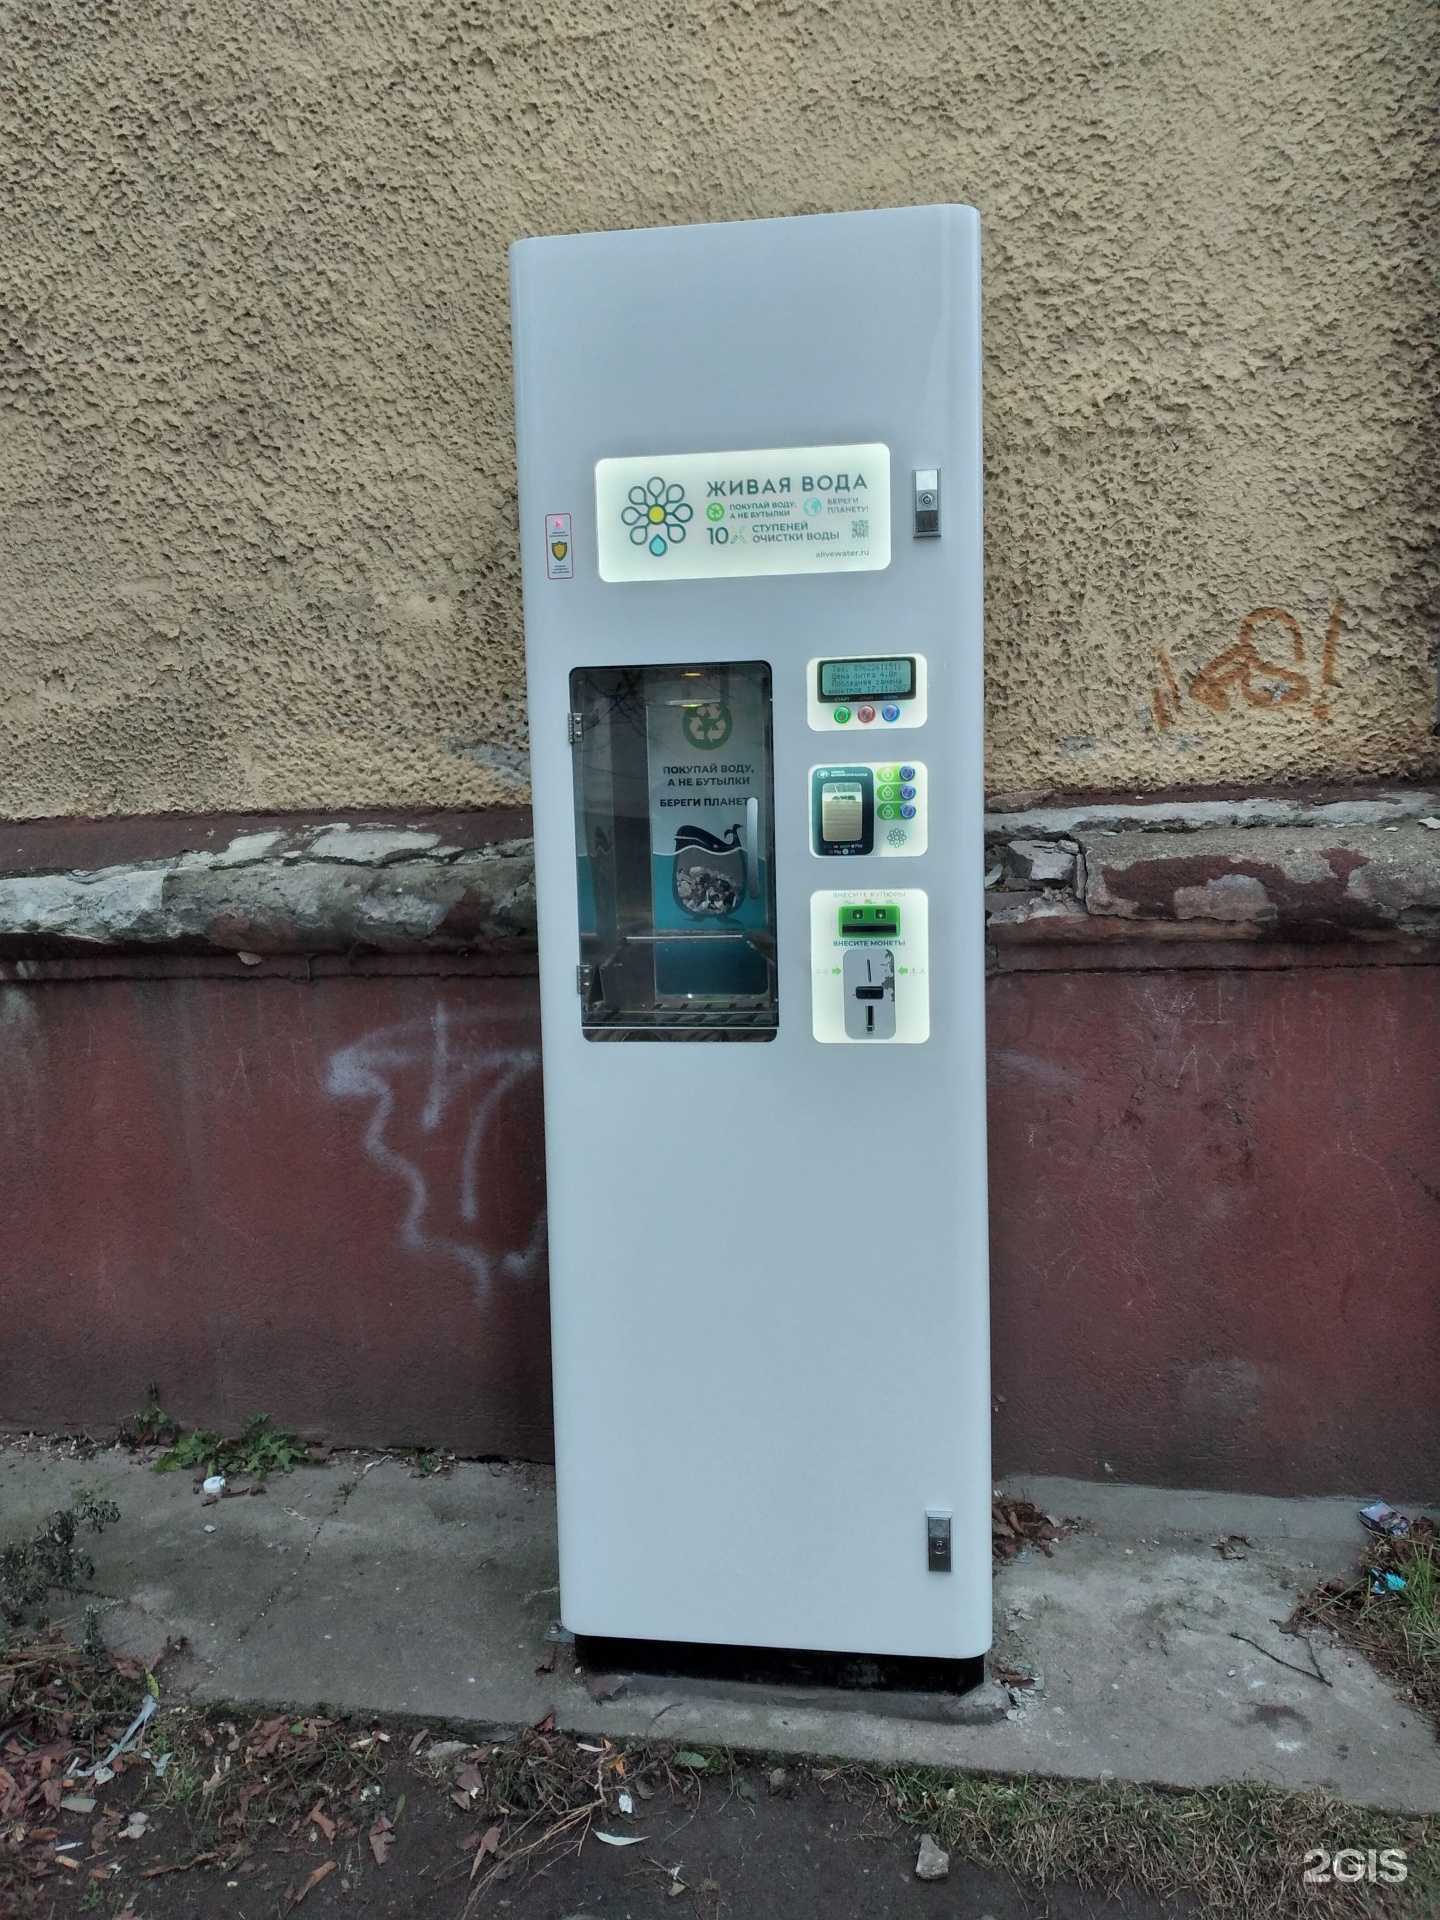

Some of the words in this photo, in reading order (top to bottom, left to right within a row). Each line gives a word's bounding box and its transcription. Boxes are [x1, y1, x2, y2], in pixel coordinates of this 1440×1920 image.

[706, 476, 791, 498] ЖИВАЯ
[801, 473, 868, 493] ВОДА
[729, 501, 770, 511] ПОКУПАЙ
[827, 505, 869, 514] ПЛАНЕТУ!
[729, 512, 736, 520] А
[737, 511, 749, 519] НЕ
[750, 509, 791, 519] БУТЫЛКИ
[752, 521, 809, 534] СТУПЕНЕЙ
[706, 526, 729, 545] 10
[752, 532, 805, 544] ОЧИСТКИ
[806, 530, 840, 542] ВОДЫ
[663, 763, 718, 775] ПОКУПАЙ
[720, 764, 755, 774] ВОДУ,
[667, 778, 675, 787] А
[678, 778, 693, 787] НЕ
[695, 776, 750, 787] БУТЫЛКИ
[660, 798, 701, 807] БЕРЕГИ
[703, 797, 749, 807] ПЛАНЕТ
